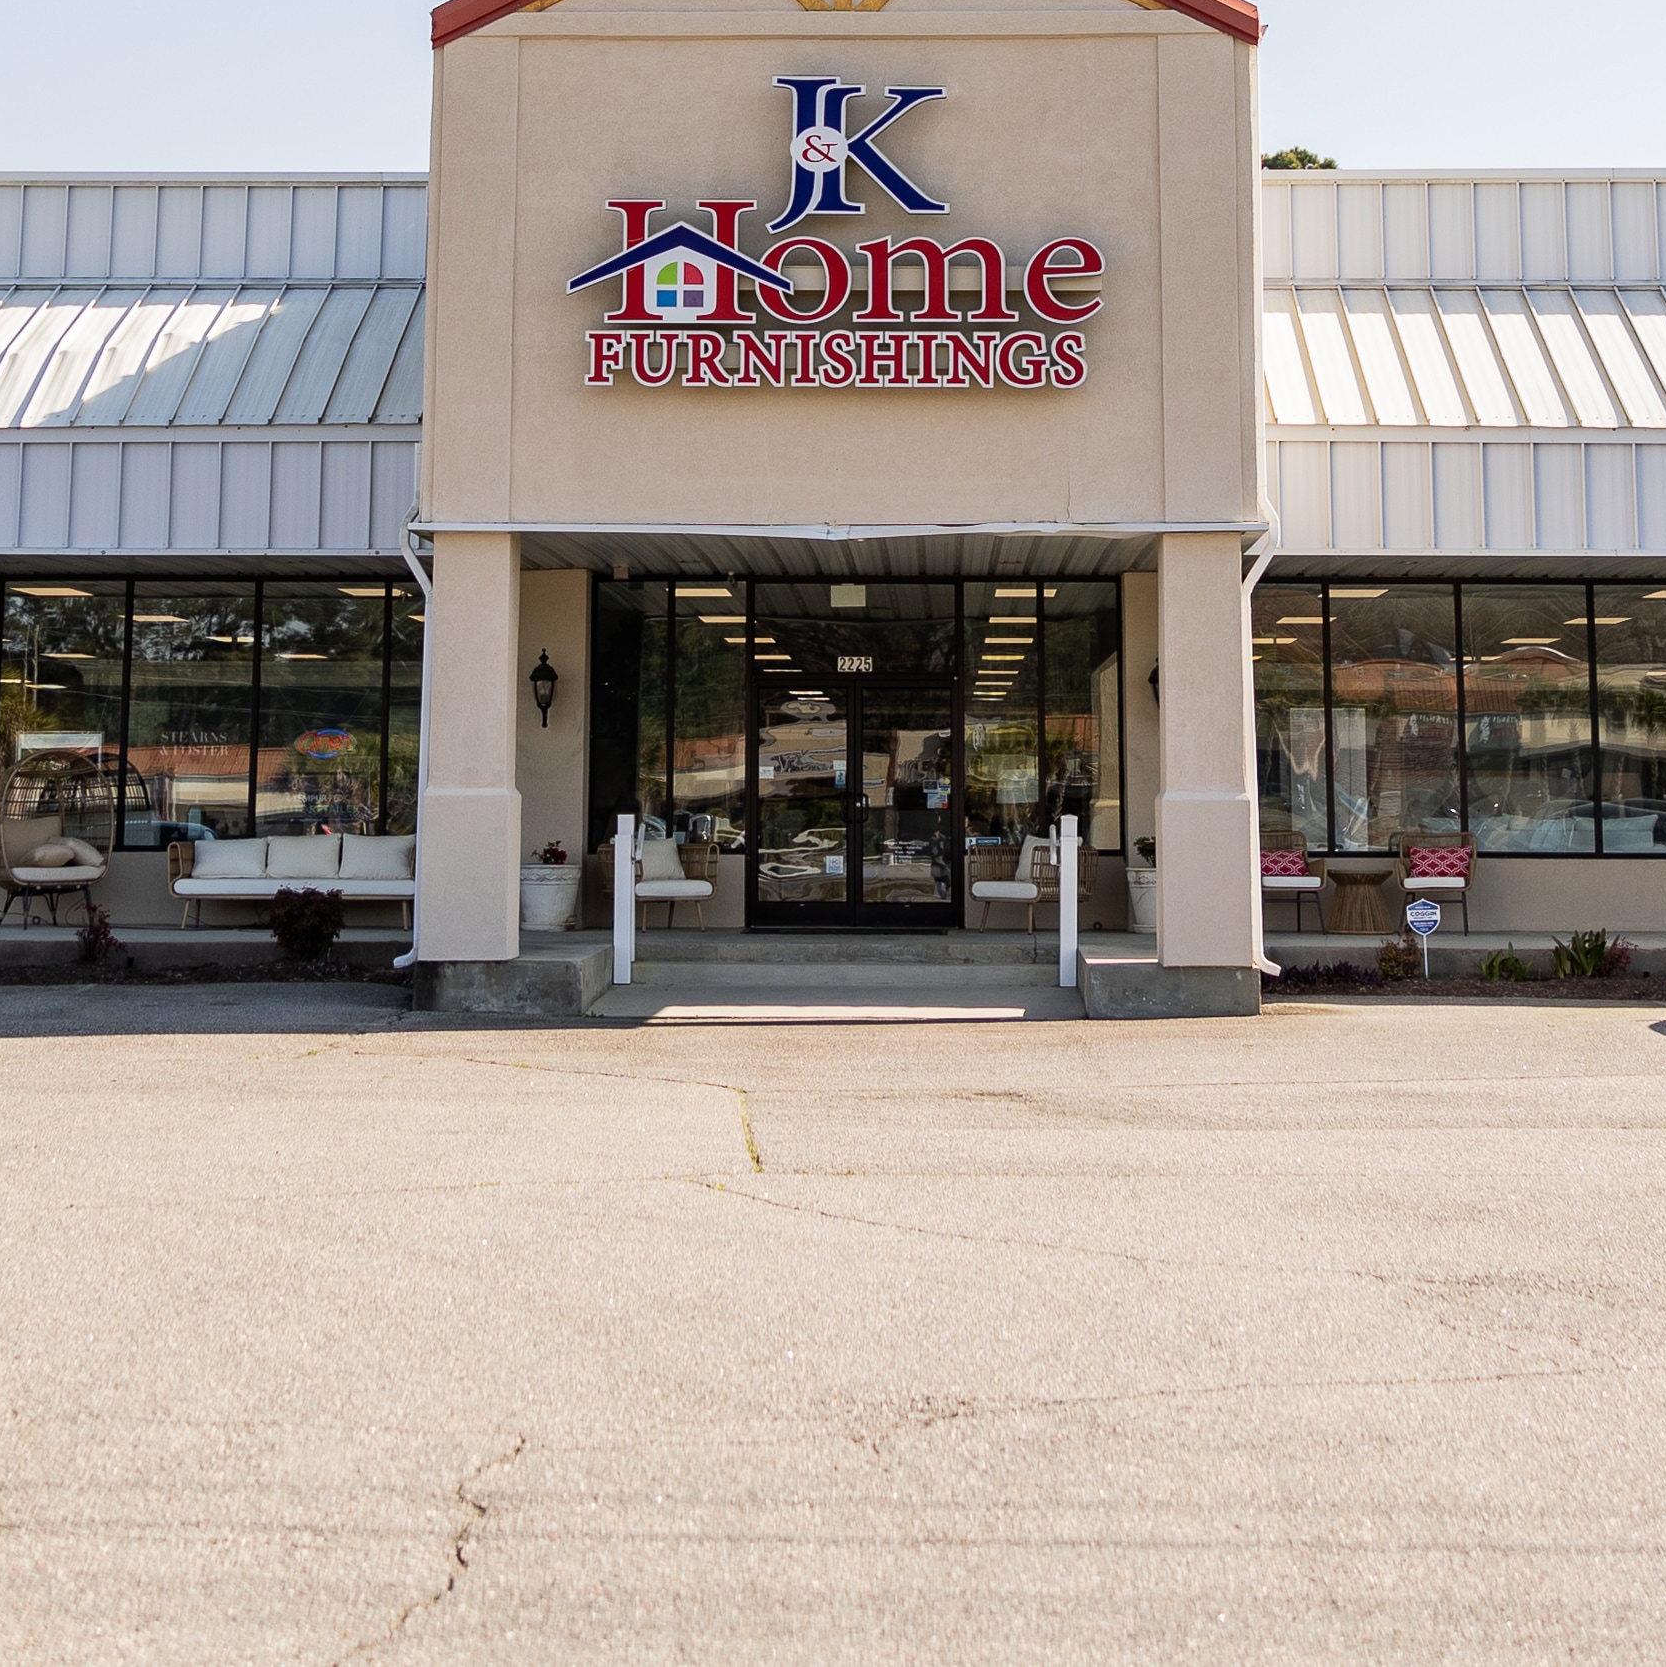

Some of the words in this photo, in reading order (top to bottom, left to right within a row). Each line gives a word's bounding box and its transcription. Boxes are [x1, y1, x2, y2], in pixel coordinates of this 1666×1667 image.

[604, 199, 1106, 324] Home
[584, 330, 1089, 389] FURNISHINGS
[838, 656, 872, 672] 2225
[160, 731, 228, 743] STEARNS
[297, 732, 352, 754] Open
[173, 745, 229, 756] FOSTER
